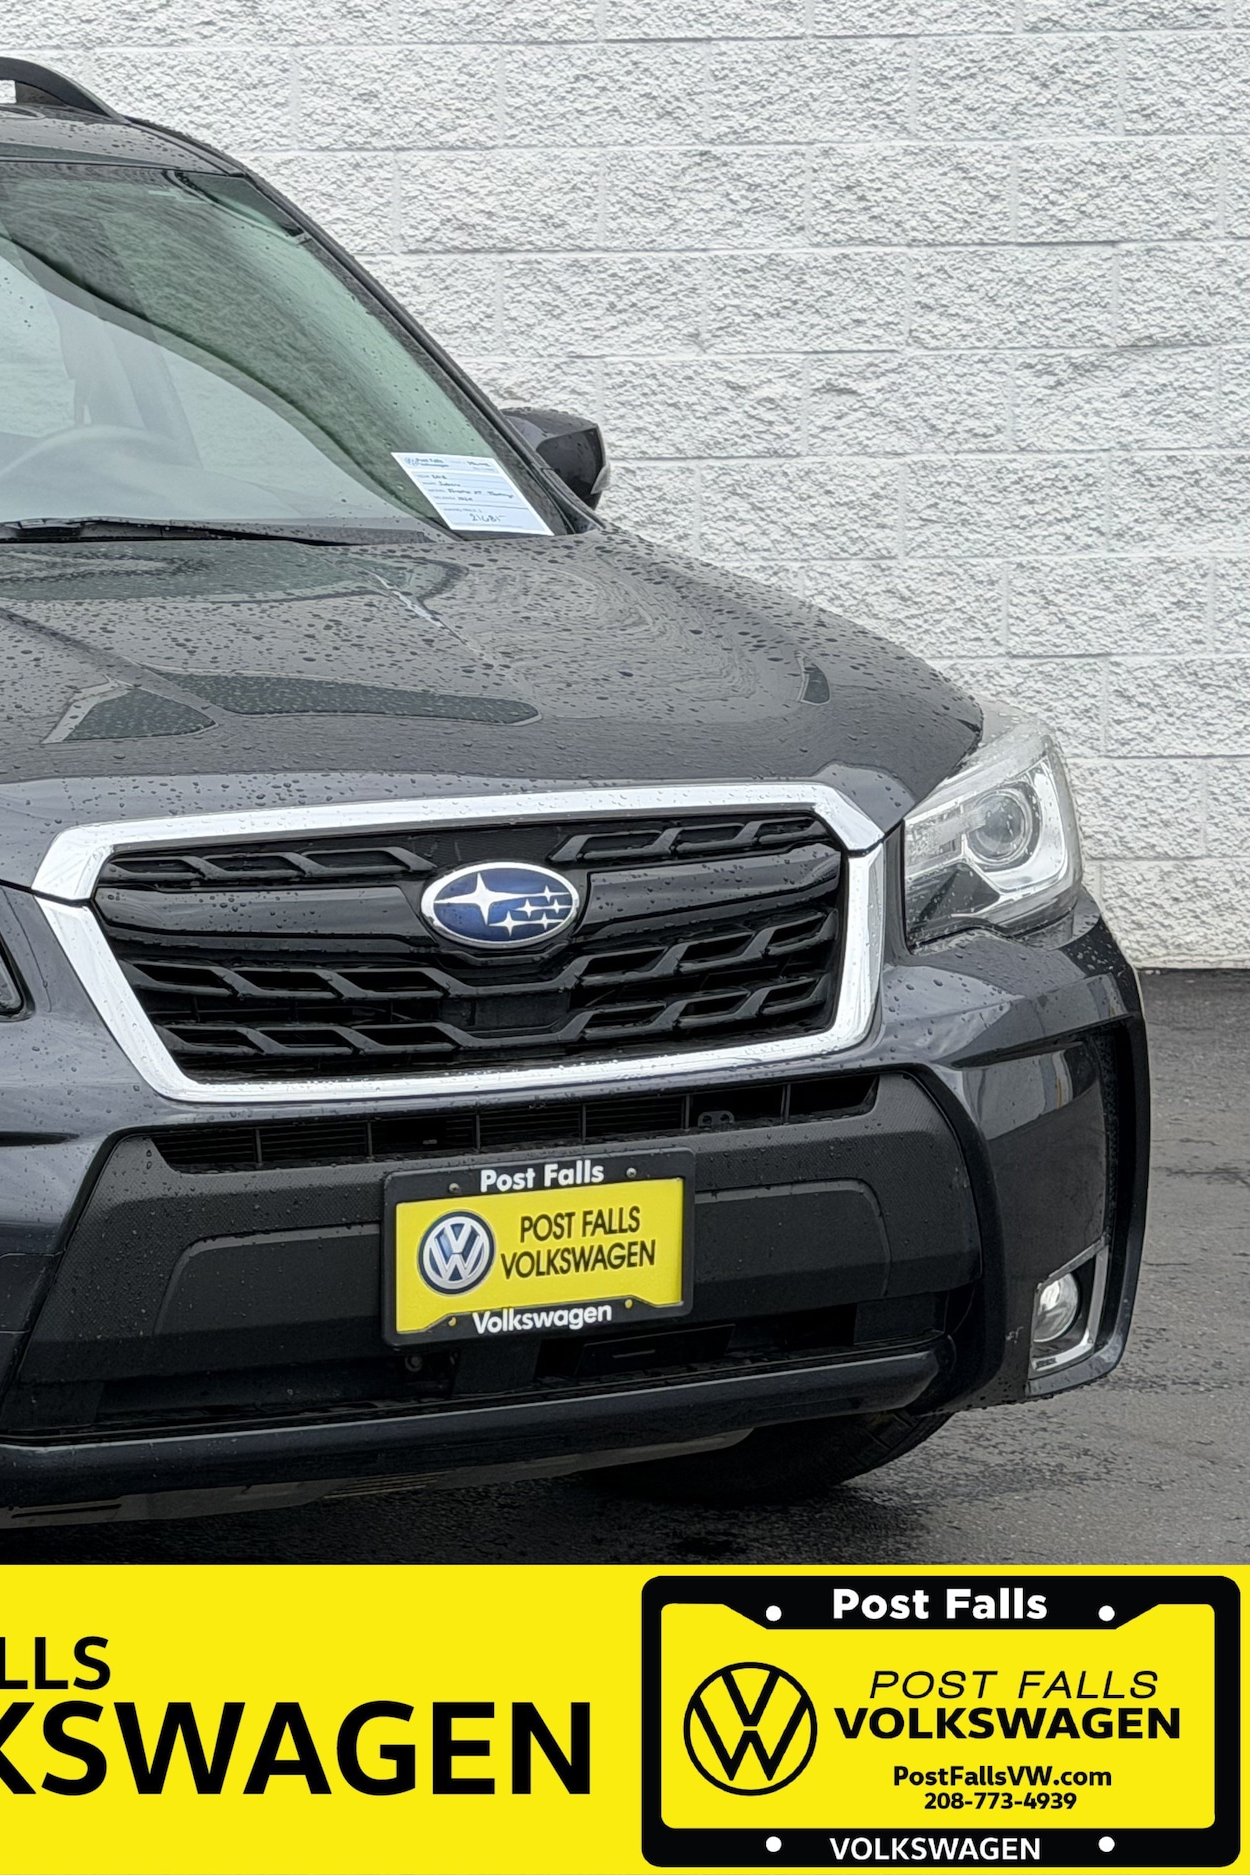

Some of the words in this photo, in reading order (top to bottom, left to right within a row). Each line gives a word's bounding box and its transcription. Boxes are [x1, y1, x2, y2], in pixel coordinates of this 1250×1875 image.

[480, 1167, 536, 1193] Post
[544, 1159, 605, 1187] Falls
[520, 1211, 575, 1243] POST
[581, 1205, 641, 1238] FALLS
[501, 1239, 656, 1280] VOLKSWAGEN
[472, 1304, 612, 1335] Volkswagen
